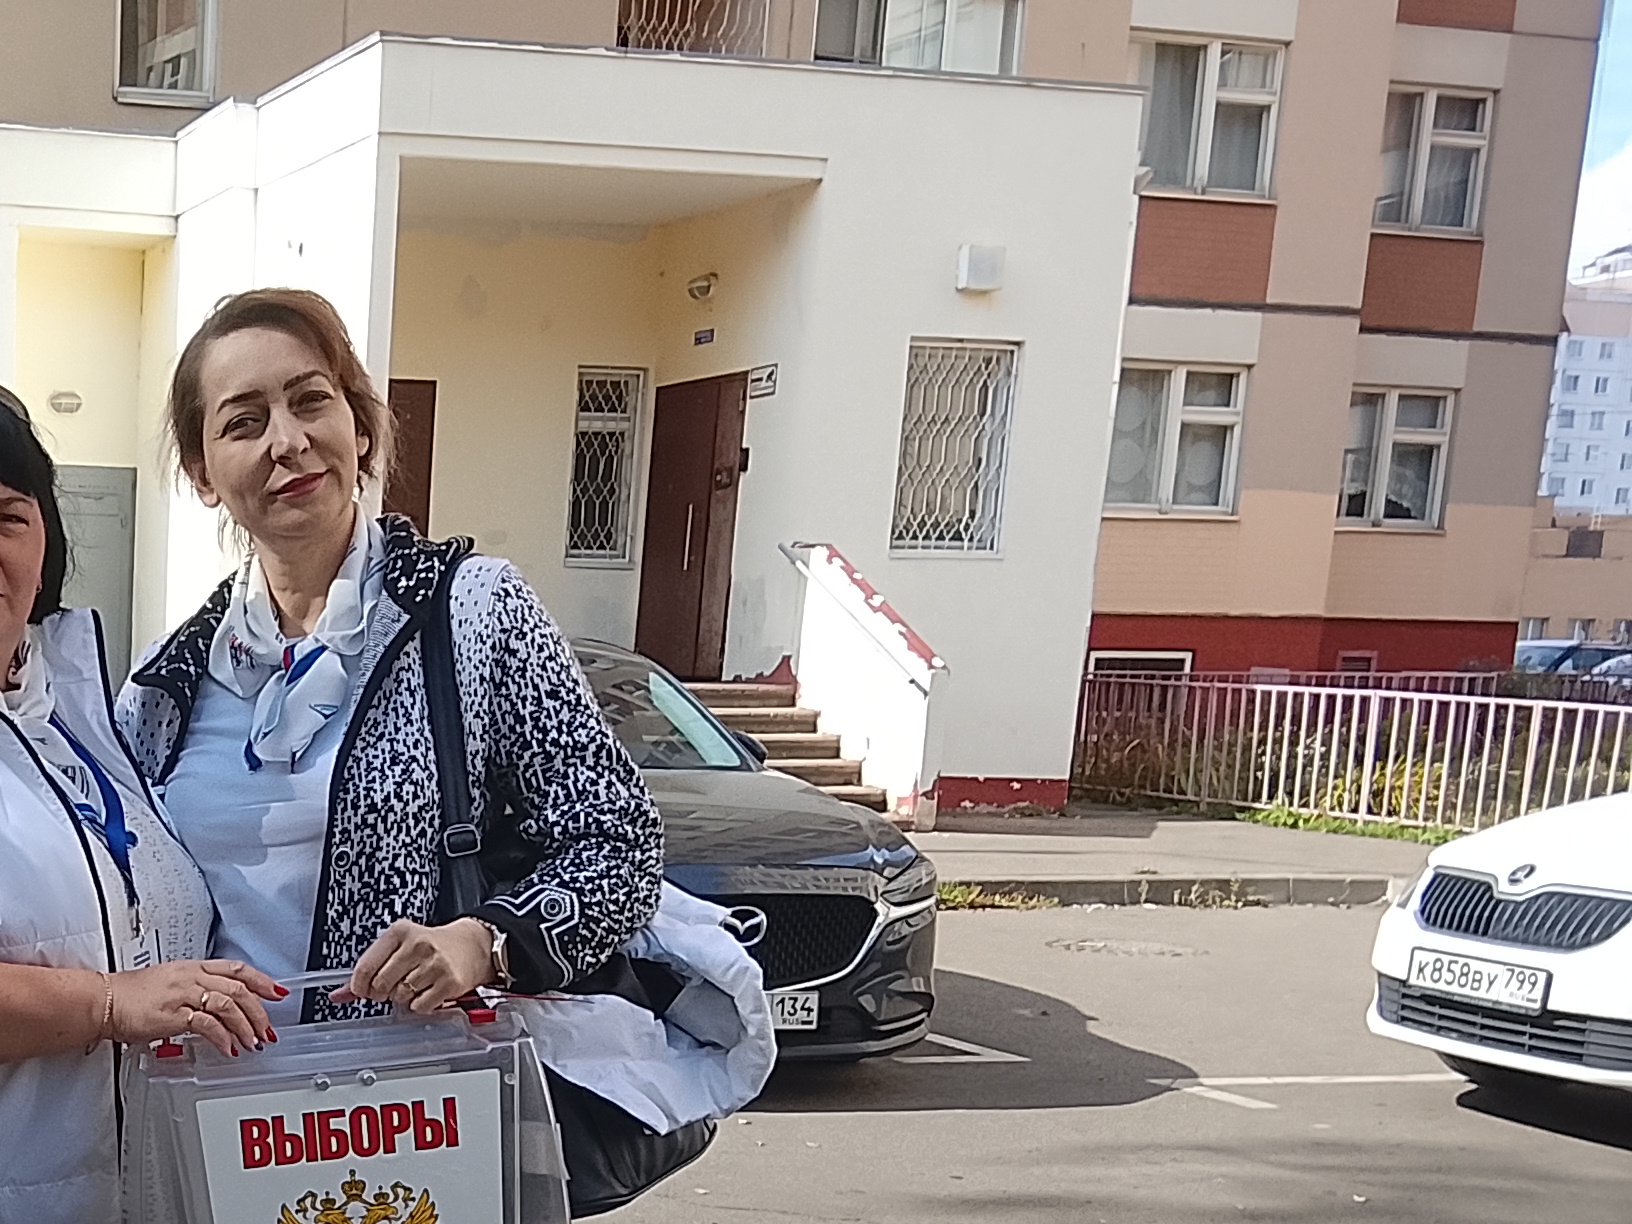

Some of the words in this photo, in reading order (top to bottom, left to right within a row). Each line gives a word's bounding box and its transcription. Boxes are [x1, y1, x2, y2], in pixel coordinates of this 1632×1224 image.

[1504, 967, 1539, 995] 799
[775, 996, 815, 1018] 134
[781, 1017, 801, 1026] RUS
[239, 1096, 460, 1171] ВЫБОРЫ
